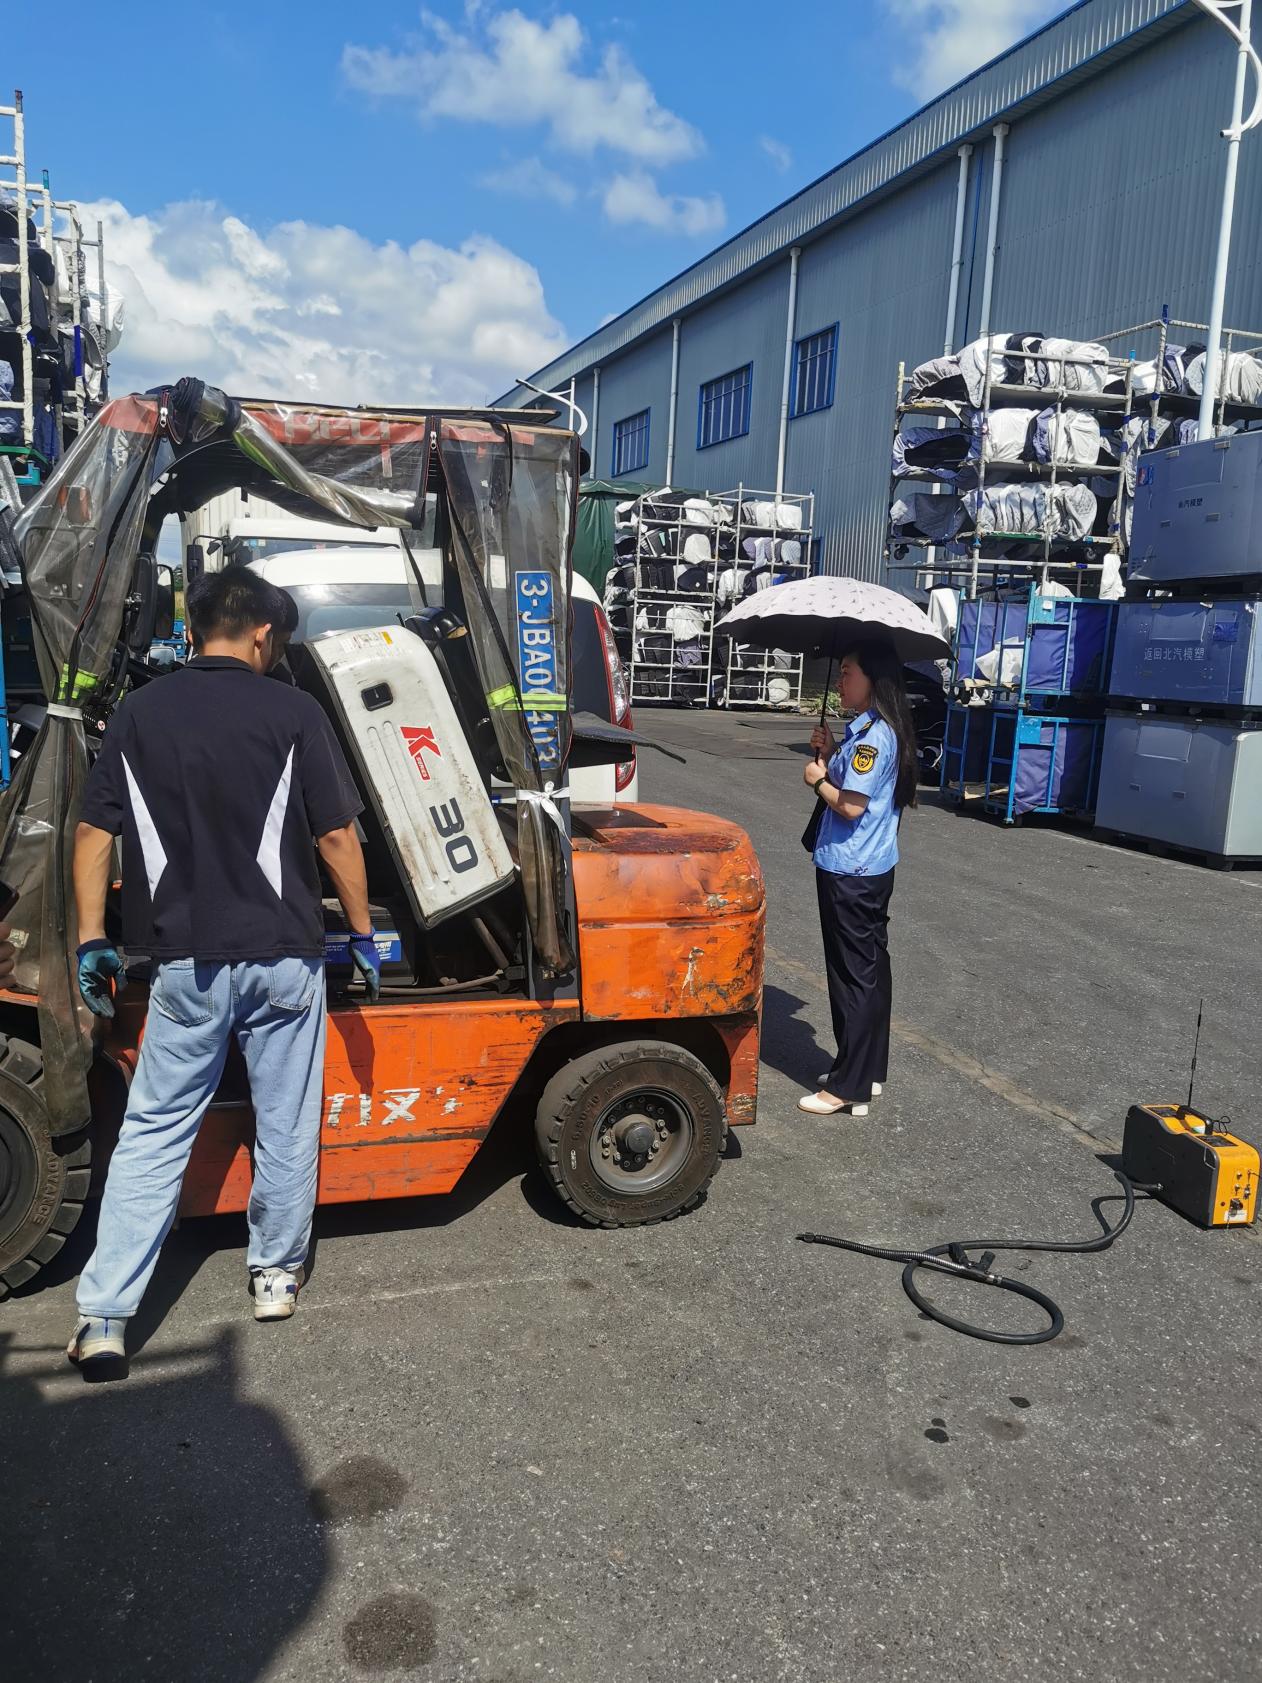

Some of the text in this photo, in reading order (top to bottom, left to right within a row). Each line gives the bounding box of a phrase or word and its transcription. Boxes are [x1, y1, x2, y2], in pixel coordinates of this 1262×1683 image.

[1144, 647, 1206, 661] 返回北汽模塑
[399, 725, 443, 758] K
[428, 797, 479, 874] 30
[33, 1151, 59, 1225] ADVANCE
